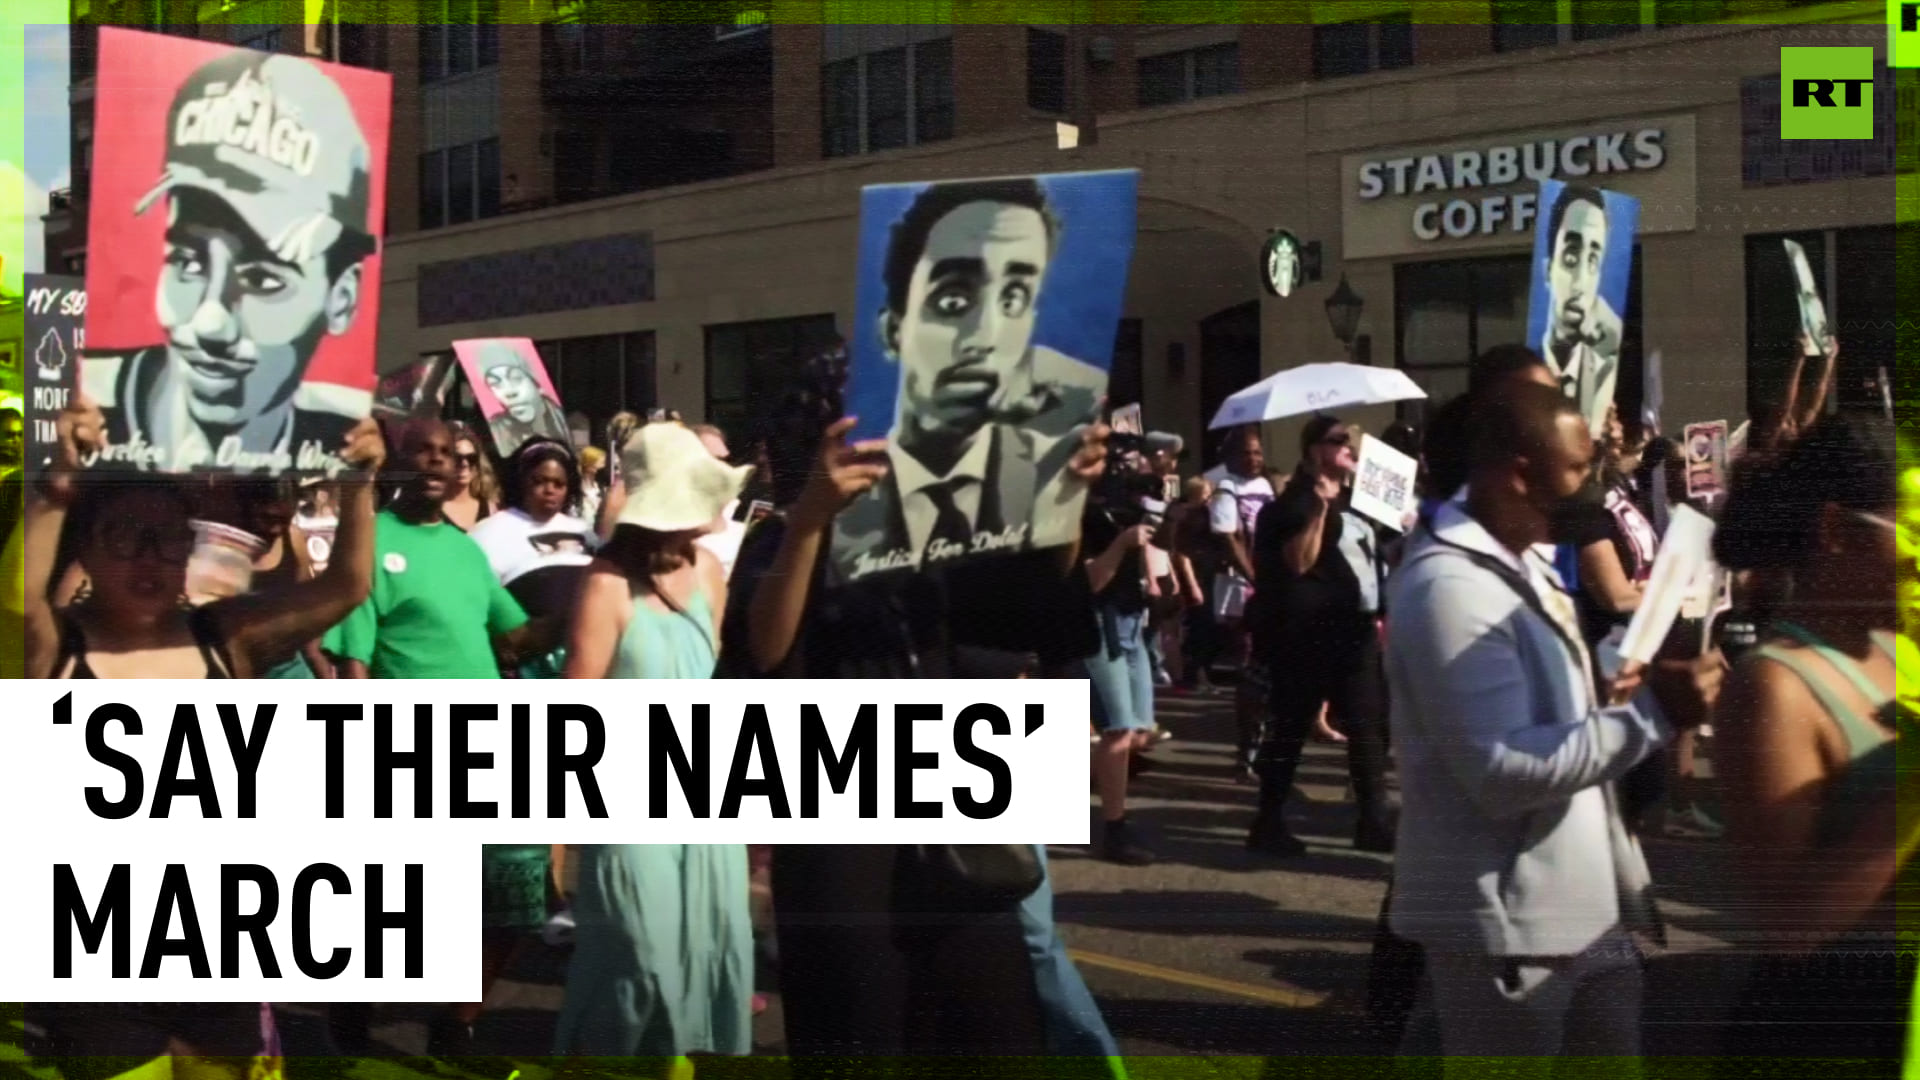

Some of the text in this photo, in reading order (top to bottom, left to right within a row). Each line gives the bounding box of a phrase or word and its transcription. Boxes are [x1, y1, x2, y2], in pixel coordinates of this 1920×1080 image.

[175, 96, 320, 176] CHICAGO
[1359, 129, 1664, 198] STARBUCKS
[1412, 193, 1536, 240] COFF
[27, 287, 88, 315] MY SO
[33, 418, 58, 443] THA
